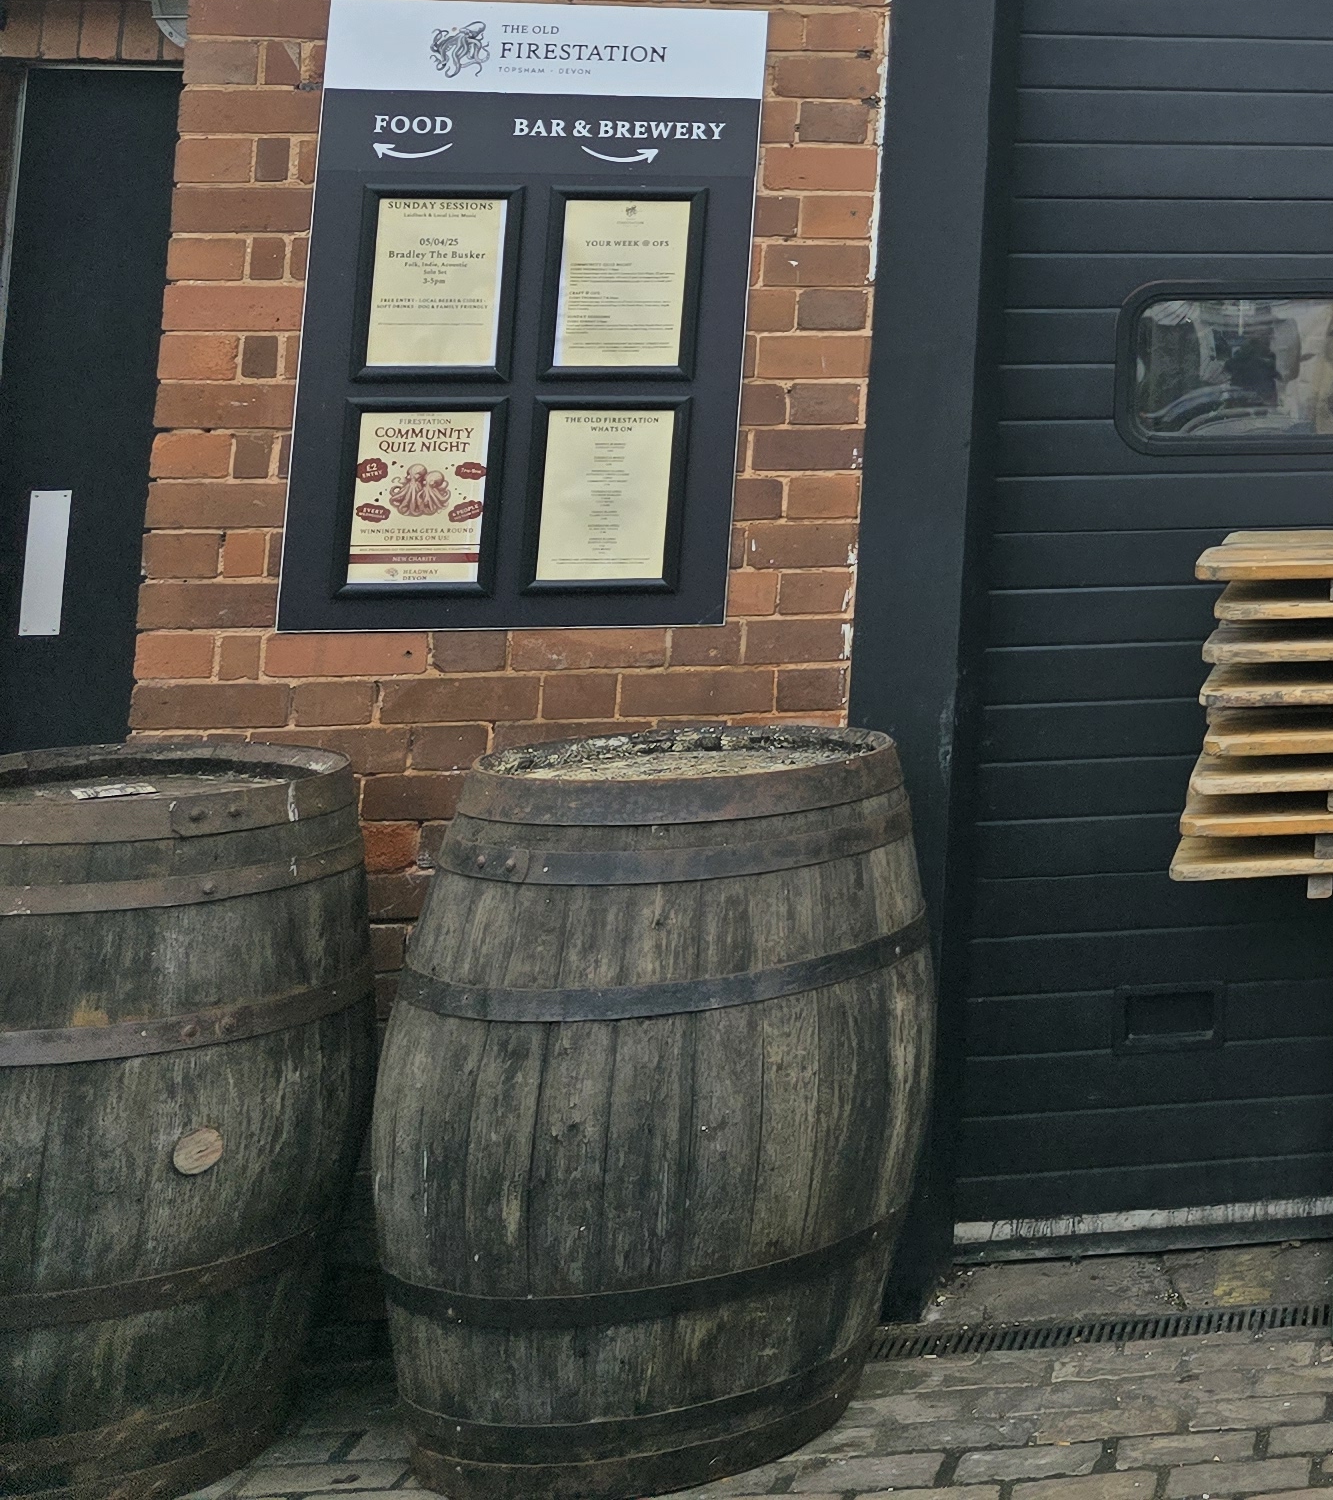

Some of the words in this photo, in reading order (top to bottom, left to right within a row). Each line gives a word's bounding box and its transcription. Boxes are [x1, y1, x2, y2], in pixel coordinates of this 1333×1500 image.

[502, 24, 529, 34] THE
[532, 24, 560, 35] OLD
[499, 41, 667, 63] FIRESTATION
[498, 66, 545, 74] TOPSHAM
[558, 67, 592, 76] DEVON
[373, 115, 453, 135] FOOD
[513, 118, 568, 138] BAR
[572, 119, 593, 138] &
[598, 120, 727, 140] BREWERY
[388, 201, 436, 210] SUNDAY
[439, 202, 493, 210] SESSIONS
[419, 237, 459, 247] 05/04/25
[388, 250, 426, 260] Bradley
[451, 251, 486, 259] Busker
[375, 427, 474, 440] COMMUNITY
[379, 440, 416, 453] QUIZ
[420, 440, 470, 453] NIGHT
[366, 463, 377, 471] £2
[457, 504, 478, 515] PEOPLE
